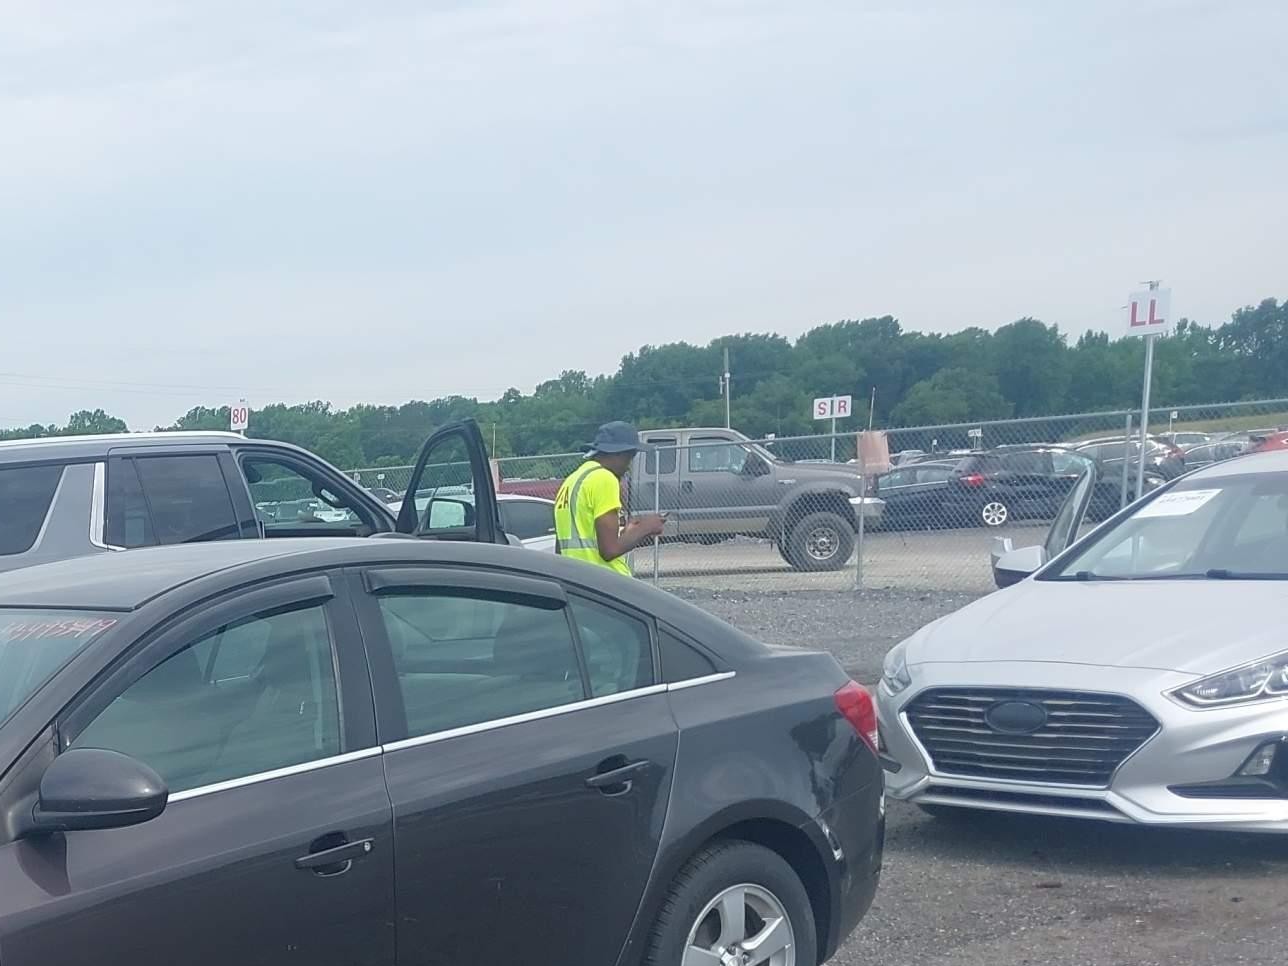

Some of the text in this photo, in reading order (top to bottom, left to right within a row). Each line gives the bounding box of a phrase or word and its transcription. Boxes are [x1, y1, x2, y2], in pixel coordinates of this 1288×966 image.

[1131, 299, 1164, 327] LL
[232, 408, 247, 424] 80
[818, 400, 847, 416] S R
